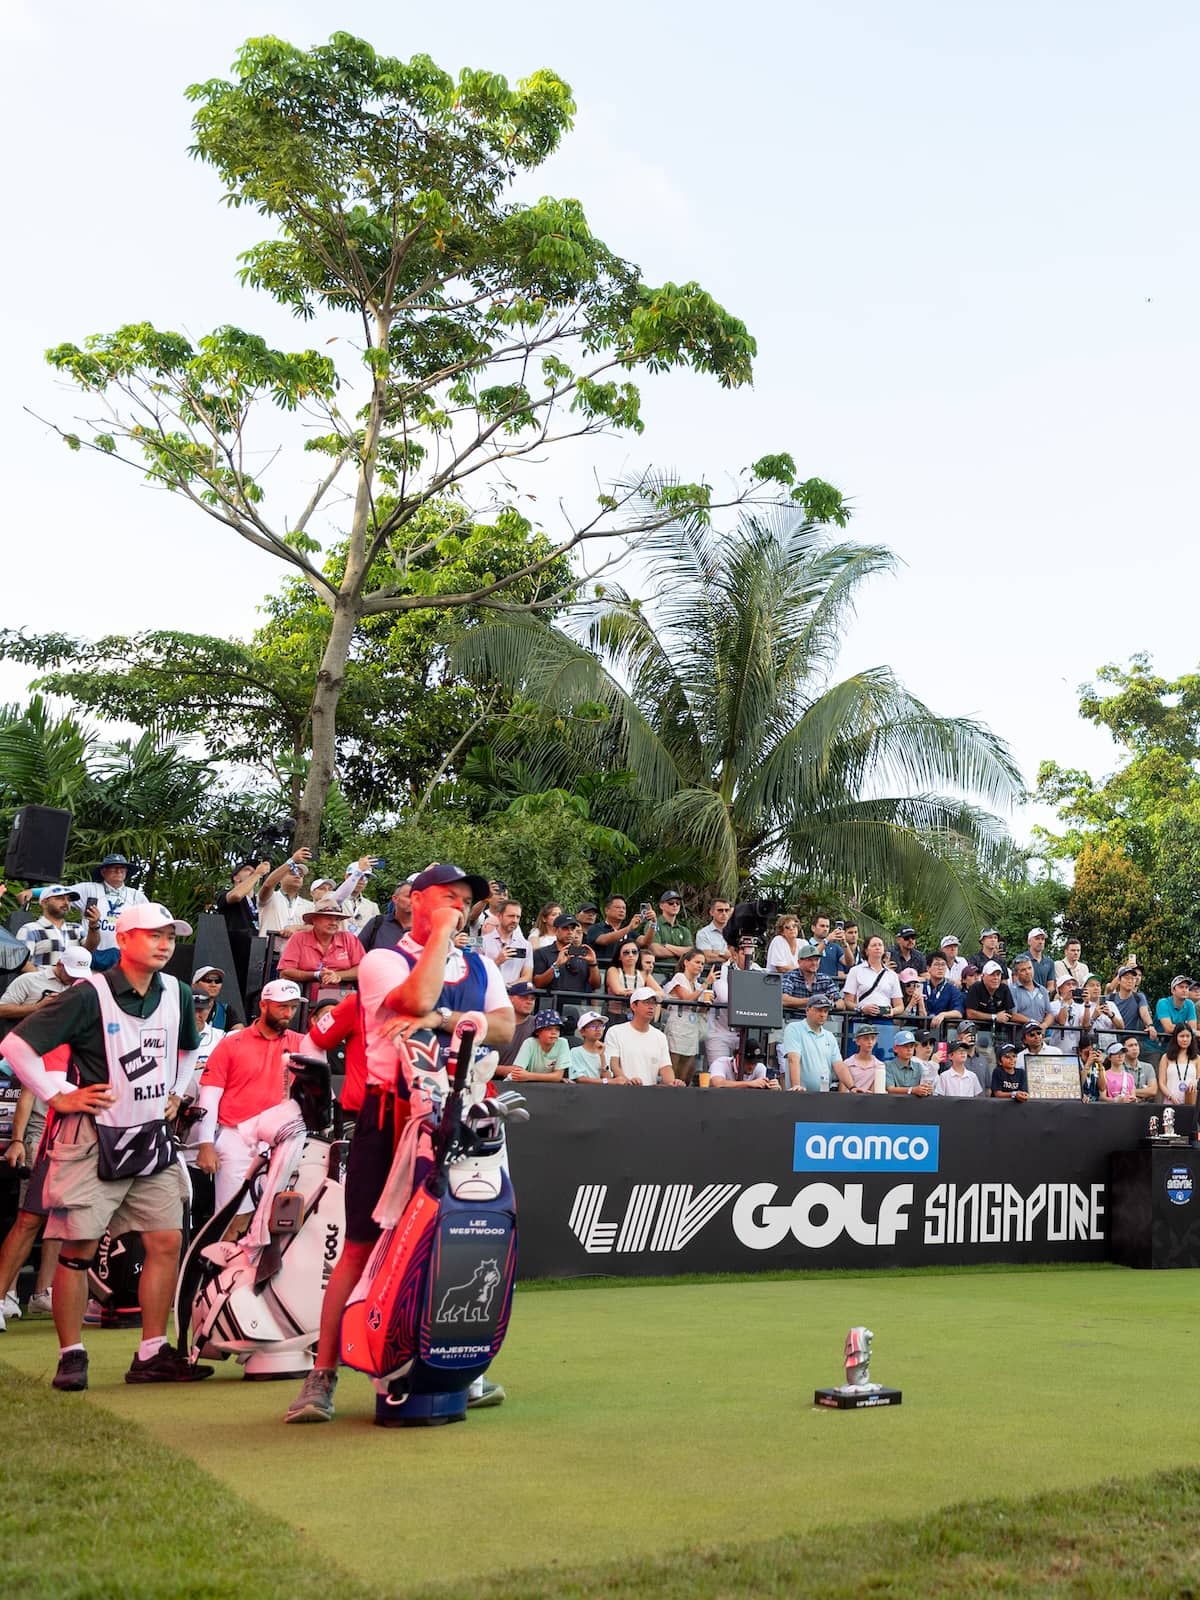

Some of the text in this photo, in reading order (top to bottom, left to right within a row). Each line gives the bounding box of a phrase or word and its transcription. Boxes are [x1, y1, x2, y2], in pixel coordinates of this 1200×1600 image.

[805, 1135, 929, 1161] aramco
[449, 1227, 506, 1235] WESTWOOD
[469, 1219, 488, 1227] LEE
[568, 1182, 1105, 1254] LIV GOLF SINGAPORE
[98, 1229, 112, 1280] Calla
[324, 1223, 340, 1261] GOLF
[429, 1345, 491, 1355] MAJESTICKS
